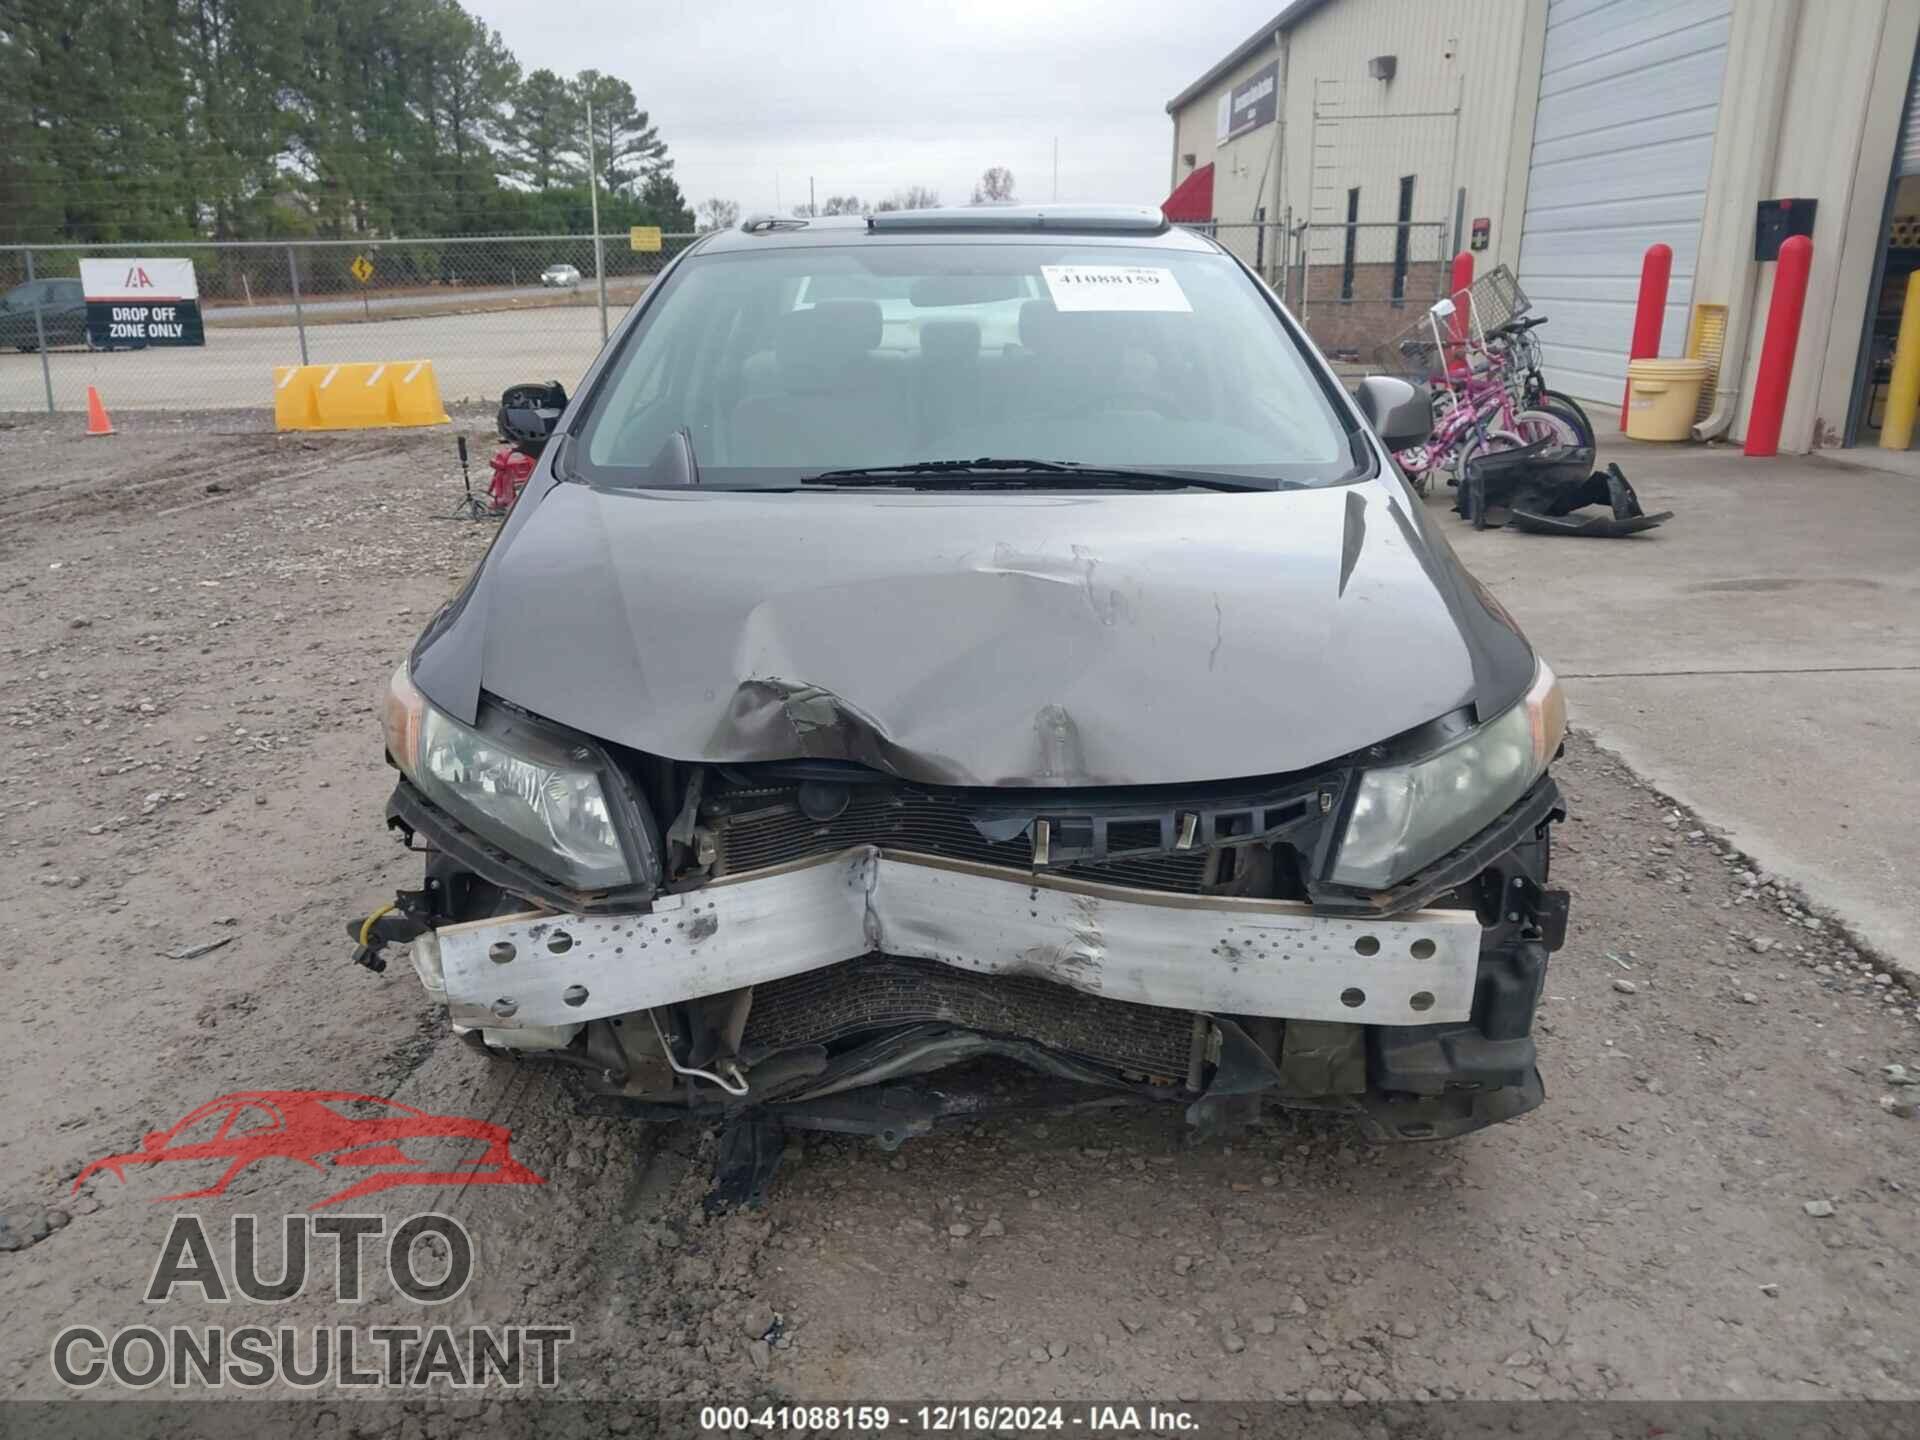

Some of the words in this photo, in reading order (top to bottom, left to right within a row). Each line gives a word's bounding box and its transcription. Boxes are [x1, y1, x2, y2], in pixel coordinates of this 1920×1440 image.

[112, 307, 149, 321] DROP
[152, 307, 176, 321] OFF
[109, 323, 146, 338] ZONE
[148, 323, 183, 338] ONLY
